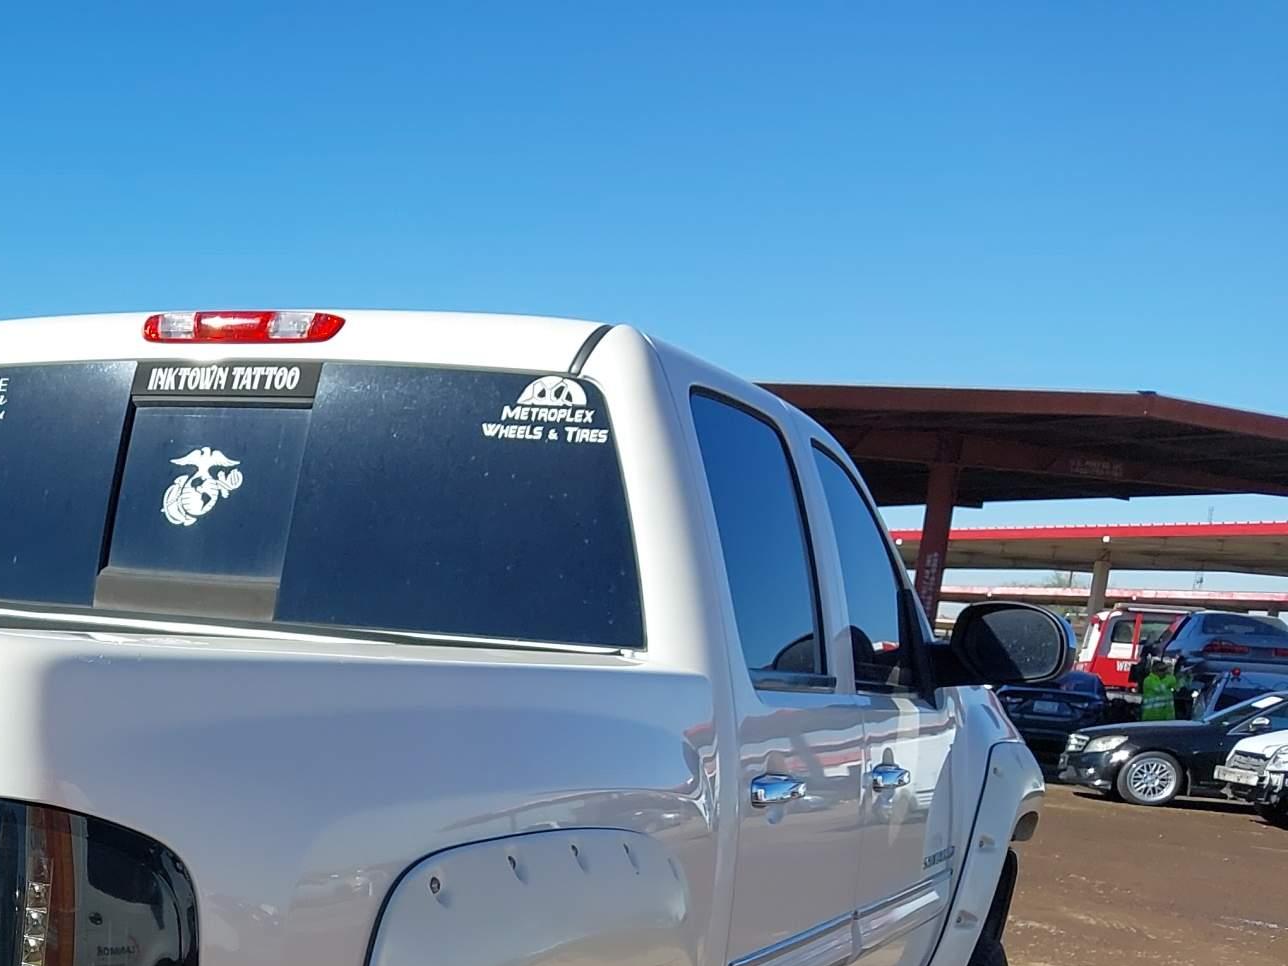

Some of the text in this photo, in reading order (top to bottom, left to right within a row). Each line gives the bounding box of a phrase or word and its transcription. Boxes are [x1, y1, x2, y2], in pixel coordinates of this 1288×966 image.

[231, 366, 300, 390] TATTOO
[500, 405, 595, 423] METROPLEX
[481, 423, 609, 443] WHEELS & TIRES
